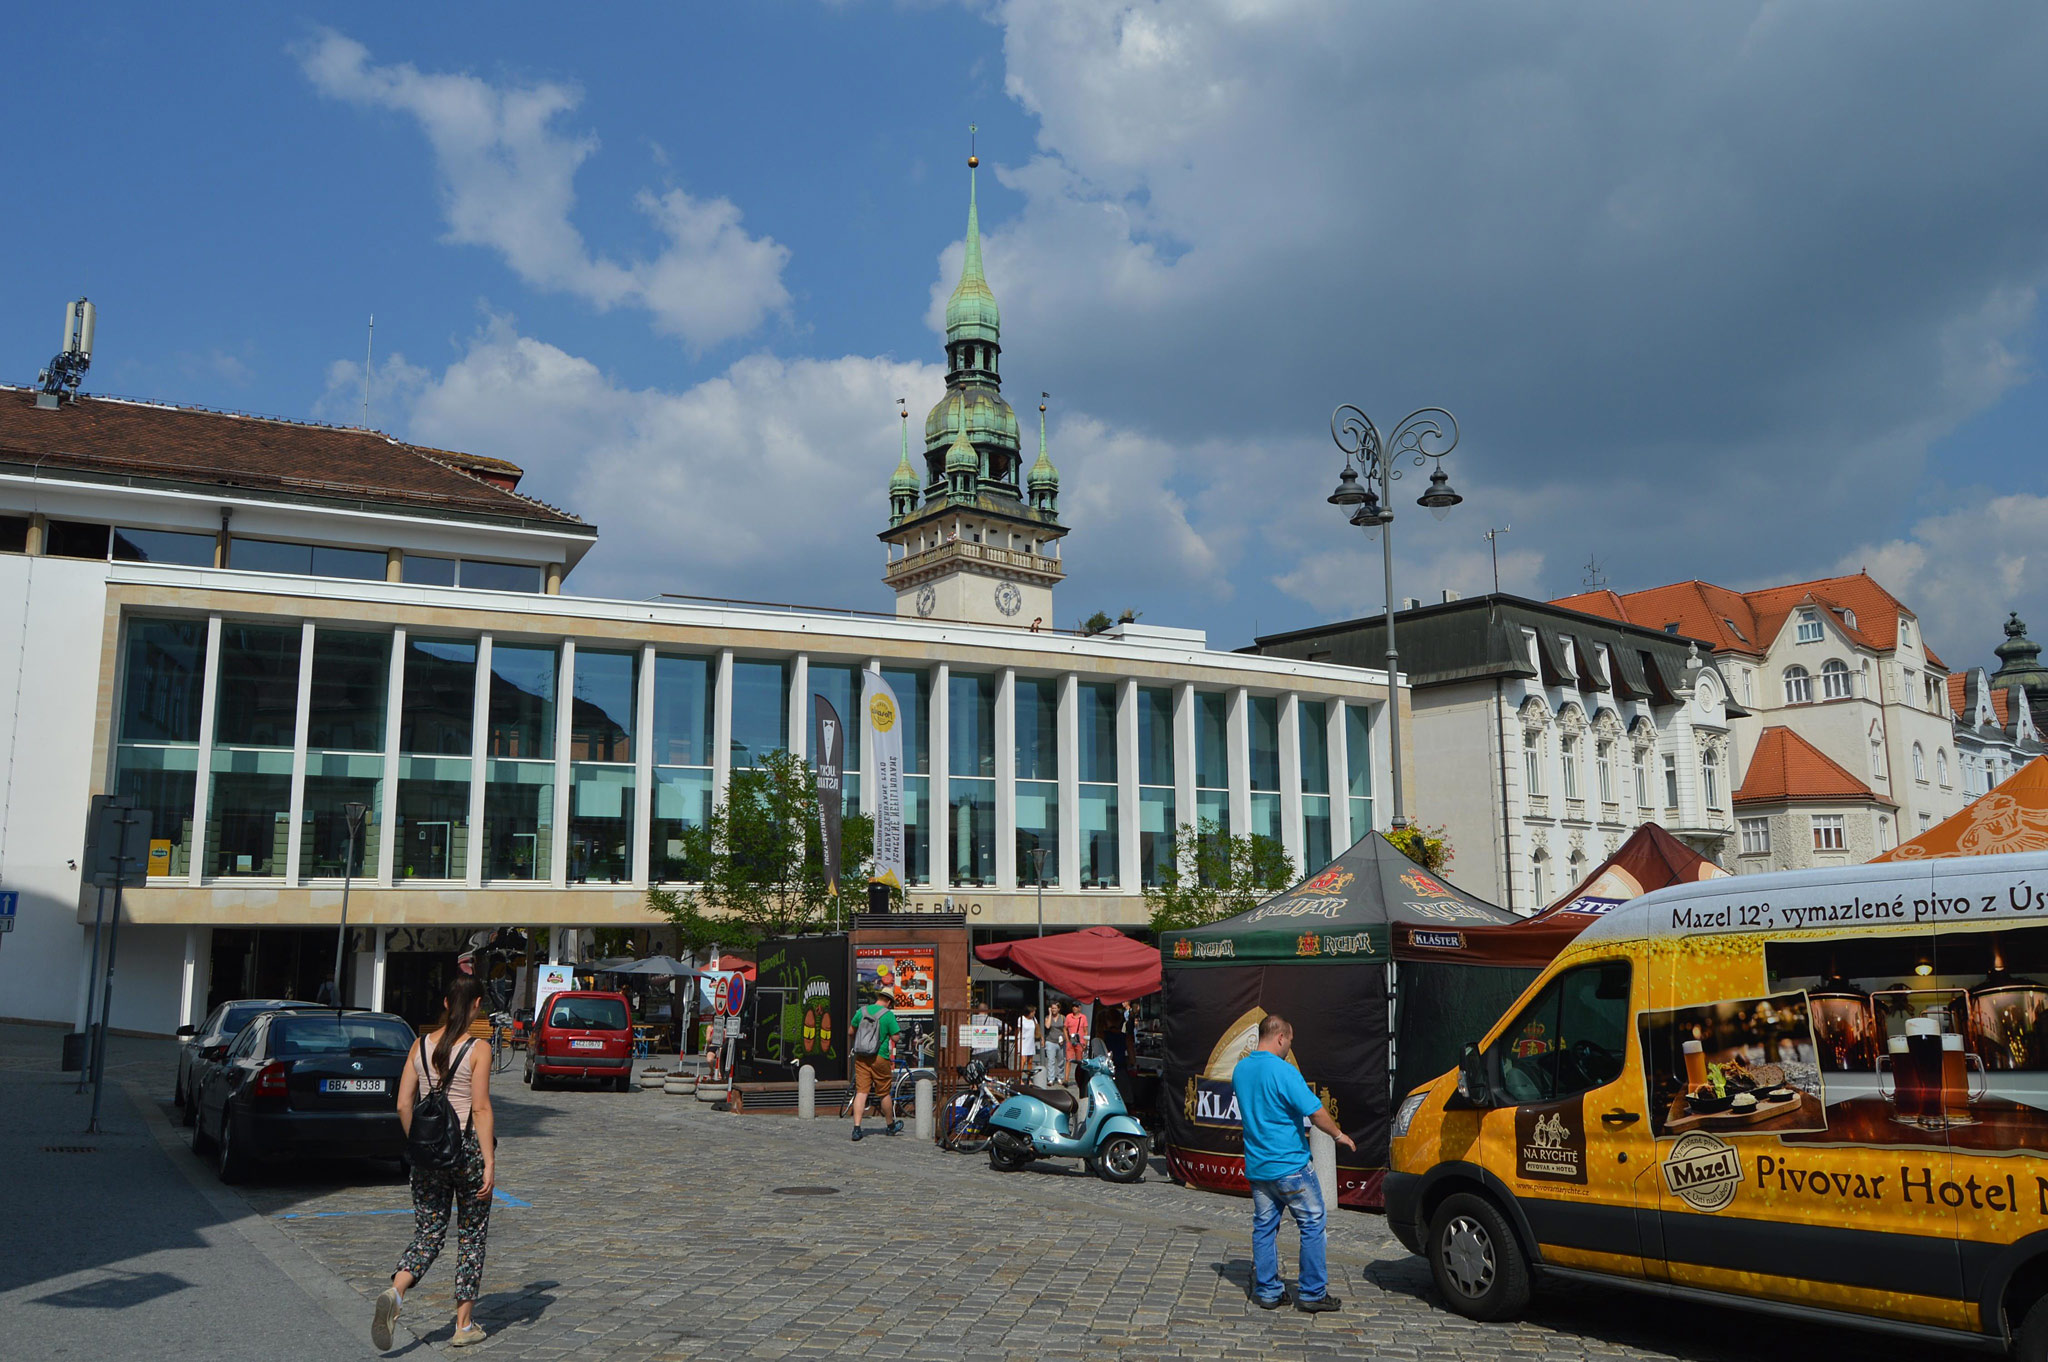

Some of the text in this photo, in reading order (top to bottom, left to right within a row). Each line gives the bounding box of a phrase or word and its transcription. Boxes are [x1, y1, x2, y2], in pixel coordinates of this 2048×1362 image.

[1671, 905, 1732, 929] Mazel
[1782, 894, 1905, 929] vymazlené
[1913, 891, 1971, 923] pivo
[1981, 895, 1997, 912] z
[2009, 879, 2048, 912] Ús
[1323, 932, 1375, 955] RYCHTÁŘ
[1415, 933, 1460, 947] KLÁŠTER
[328, 1080, 381, 1091] 6B4 9338
[1196, 1089, 1244, 1121] KLÁ
[1703, 1139, 1719, 1151] pivo
[1523, 1148, 1579, 1163] NA RYCHTĚ
[1527, 1163, 1575, 1173] PIVOVAR HOTEL
[1672, 1154, 1732, 1187] Mazel
[1756, 1155, 1885, 1199] Pivovar
[1900, 1166, 2018, 1213] Hotel
